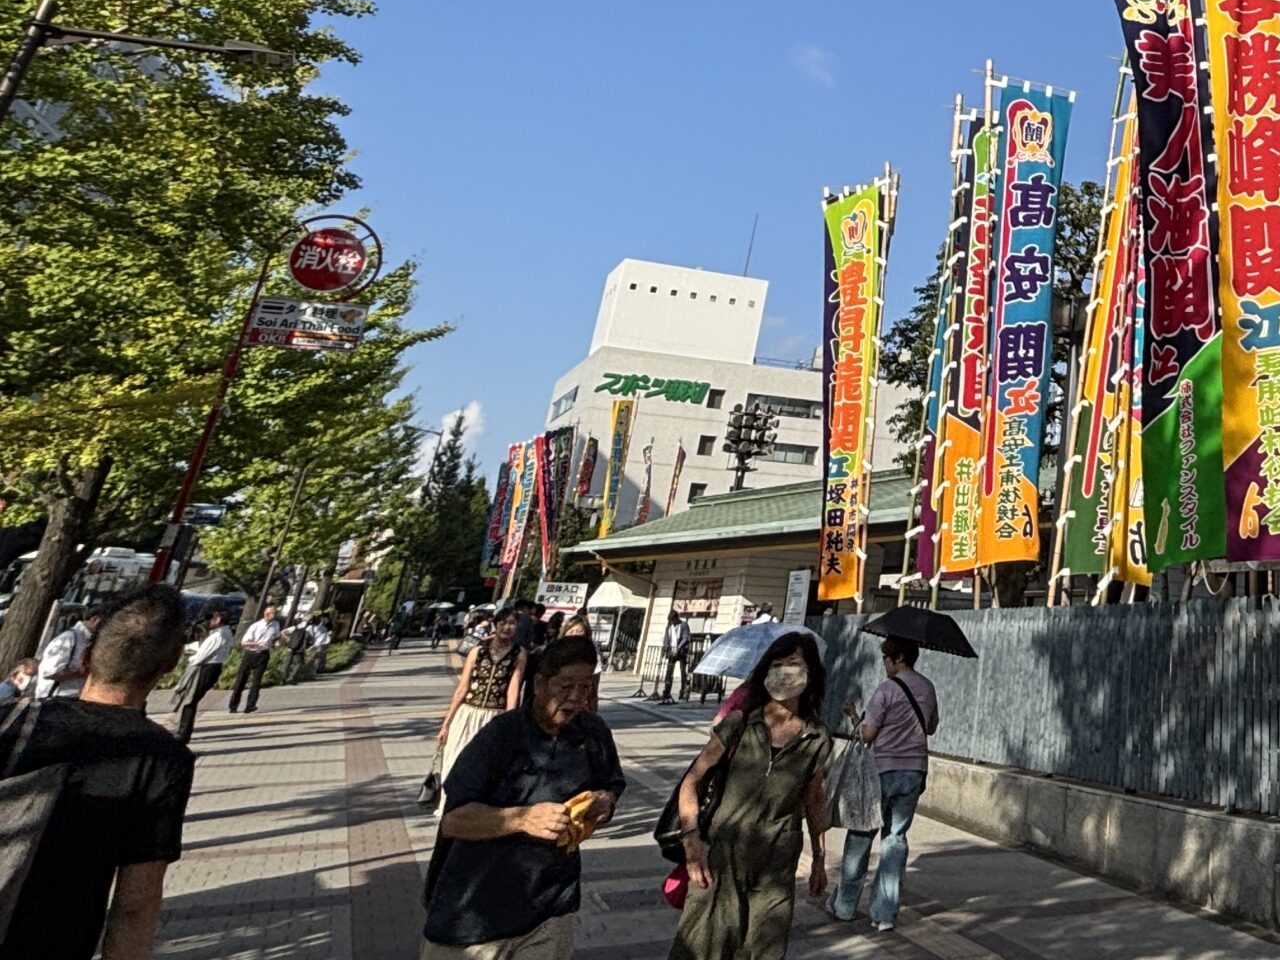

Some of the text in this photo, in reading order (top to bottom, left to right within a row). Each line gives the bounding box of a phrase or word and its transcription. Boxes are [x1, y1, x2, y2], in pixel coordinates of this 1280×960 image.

[294, 244, 362, 275] 消火栓
[286, 303, 338, 320] タイ料理
[256, 317, 278, 328] Soi
